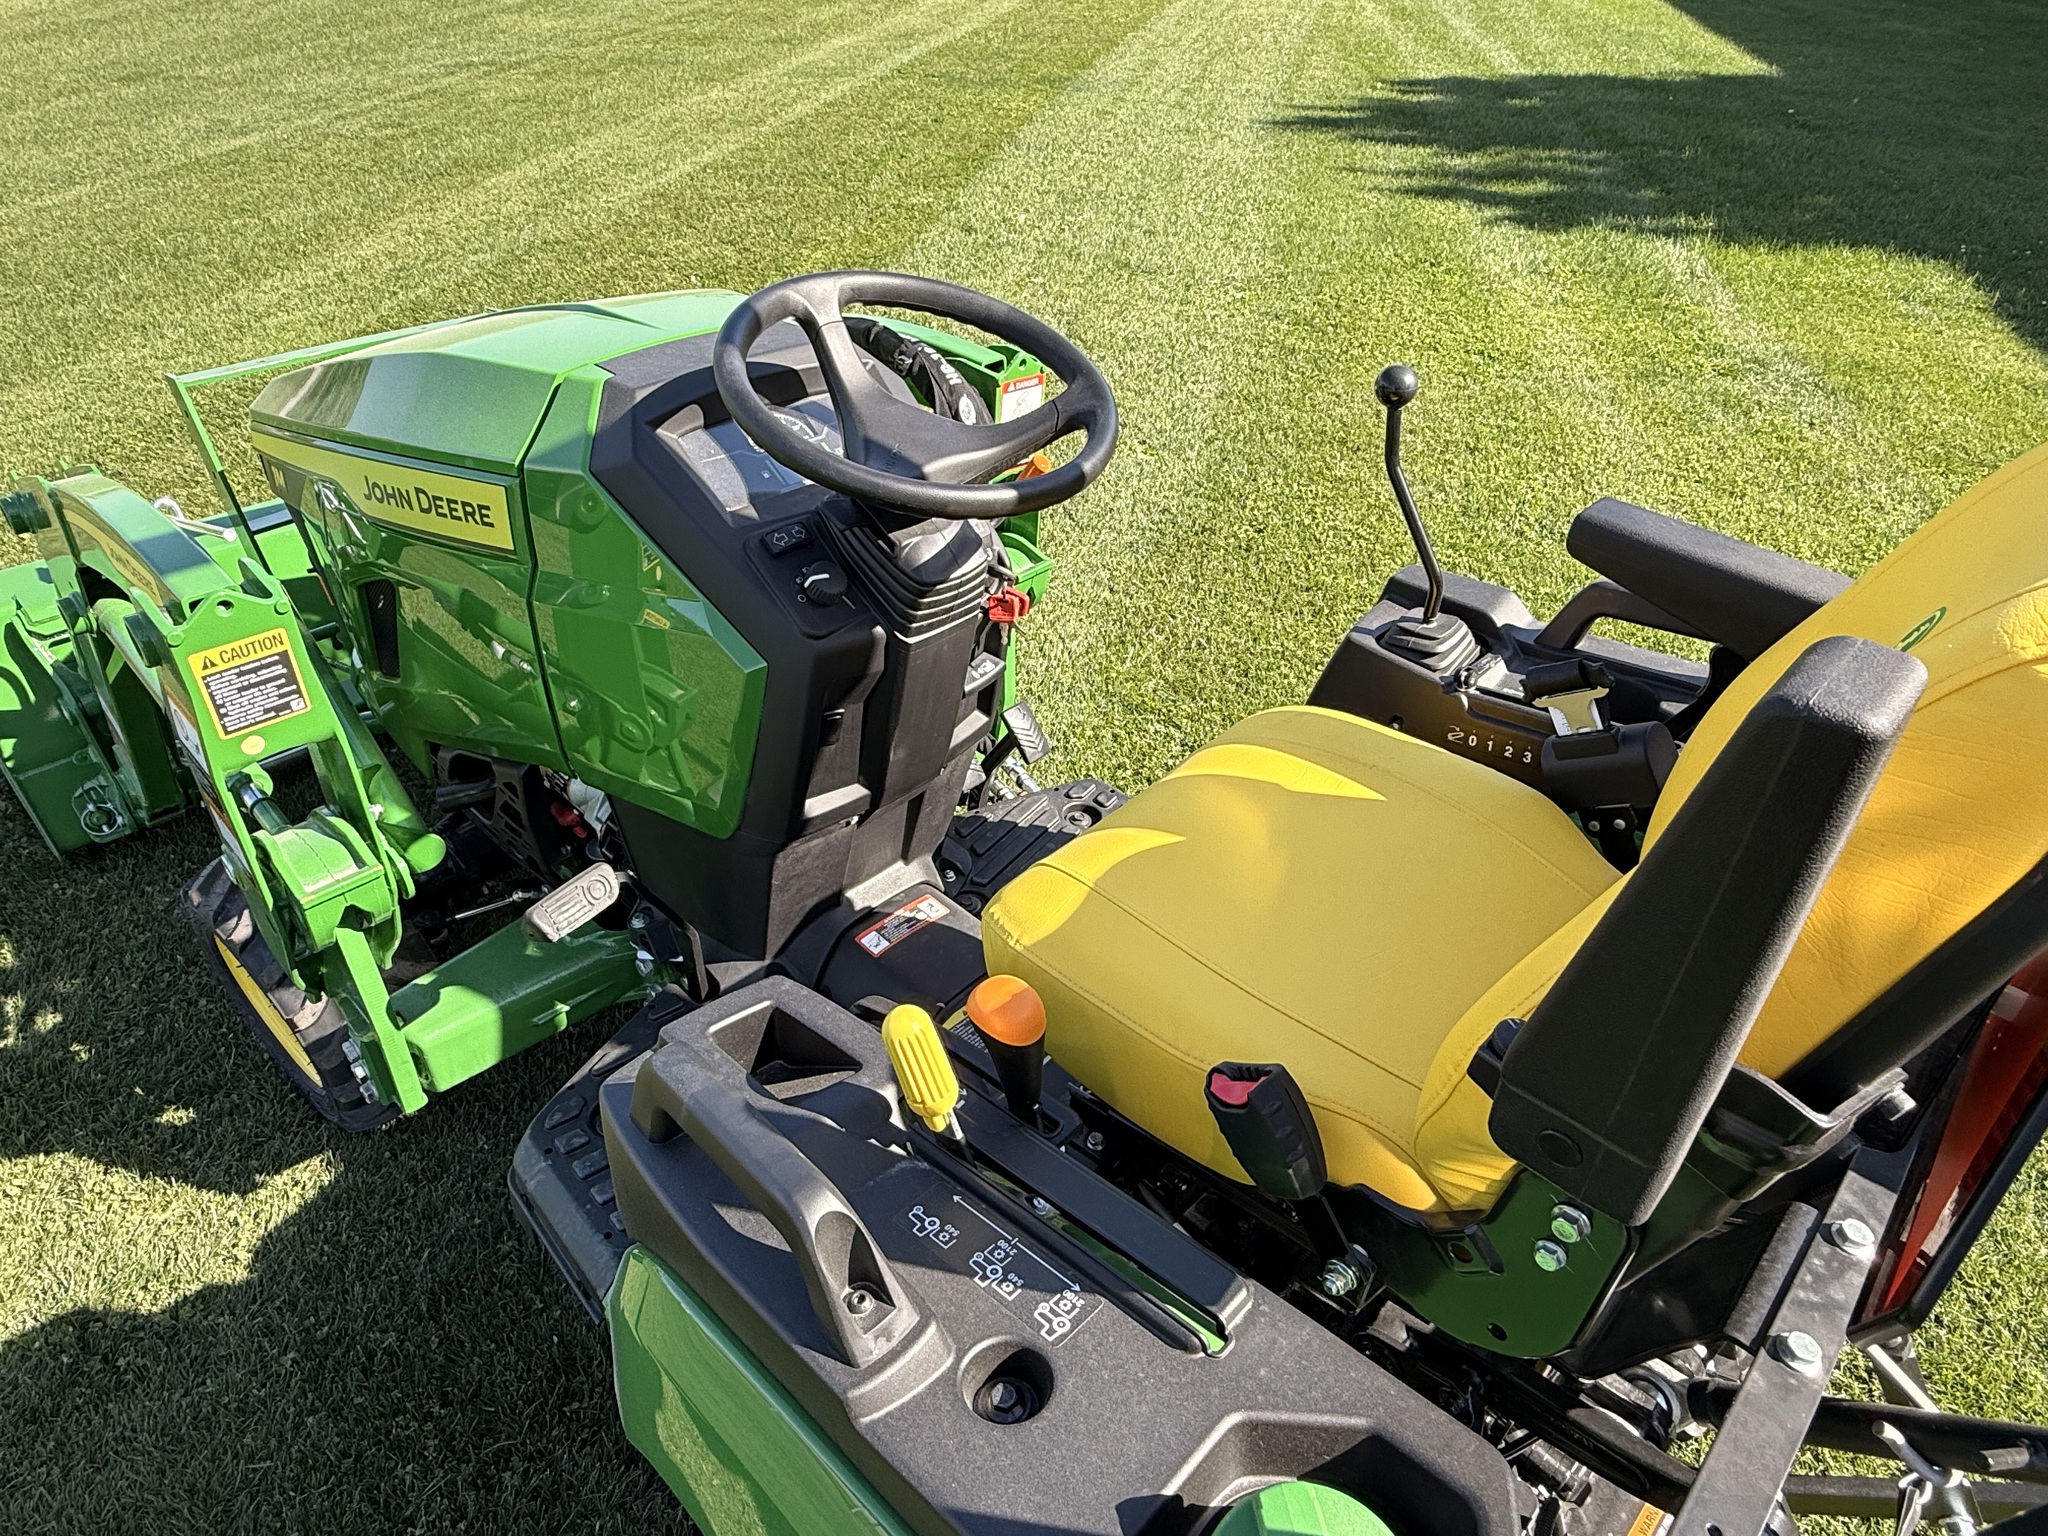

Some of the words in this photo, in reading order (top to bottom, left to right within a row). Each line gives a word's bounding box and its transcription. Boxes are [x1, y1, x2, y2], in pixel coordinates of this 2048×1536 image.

[363, 475, 414, 511] JOHN
[414, 486, 495, 528] DEERE
[219, 632, 285, 664] CAUTION
[1468, 735, 1478, 747] 0
[1486, 740, 1494, 752] 1
[1503, 745, 1514, 758] 2
[1522, 751, 1533, 763] 3
[943, 1224, 961, 1238] 540
[996, 1239, 1019, 1256] 2100
[1007, 1272, 1025, 1287] 540
[1062, 1288, 1086, 1308] 2100
